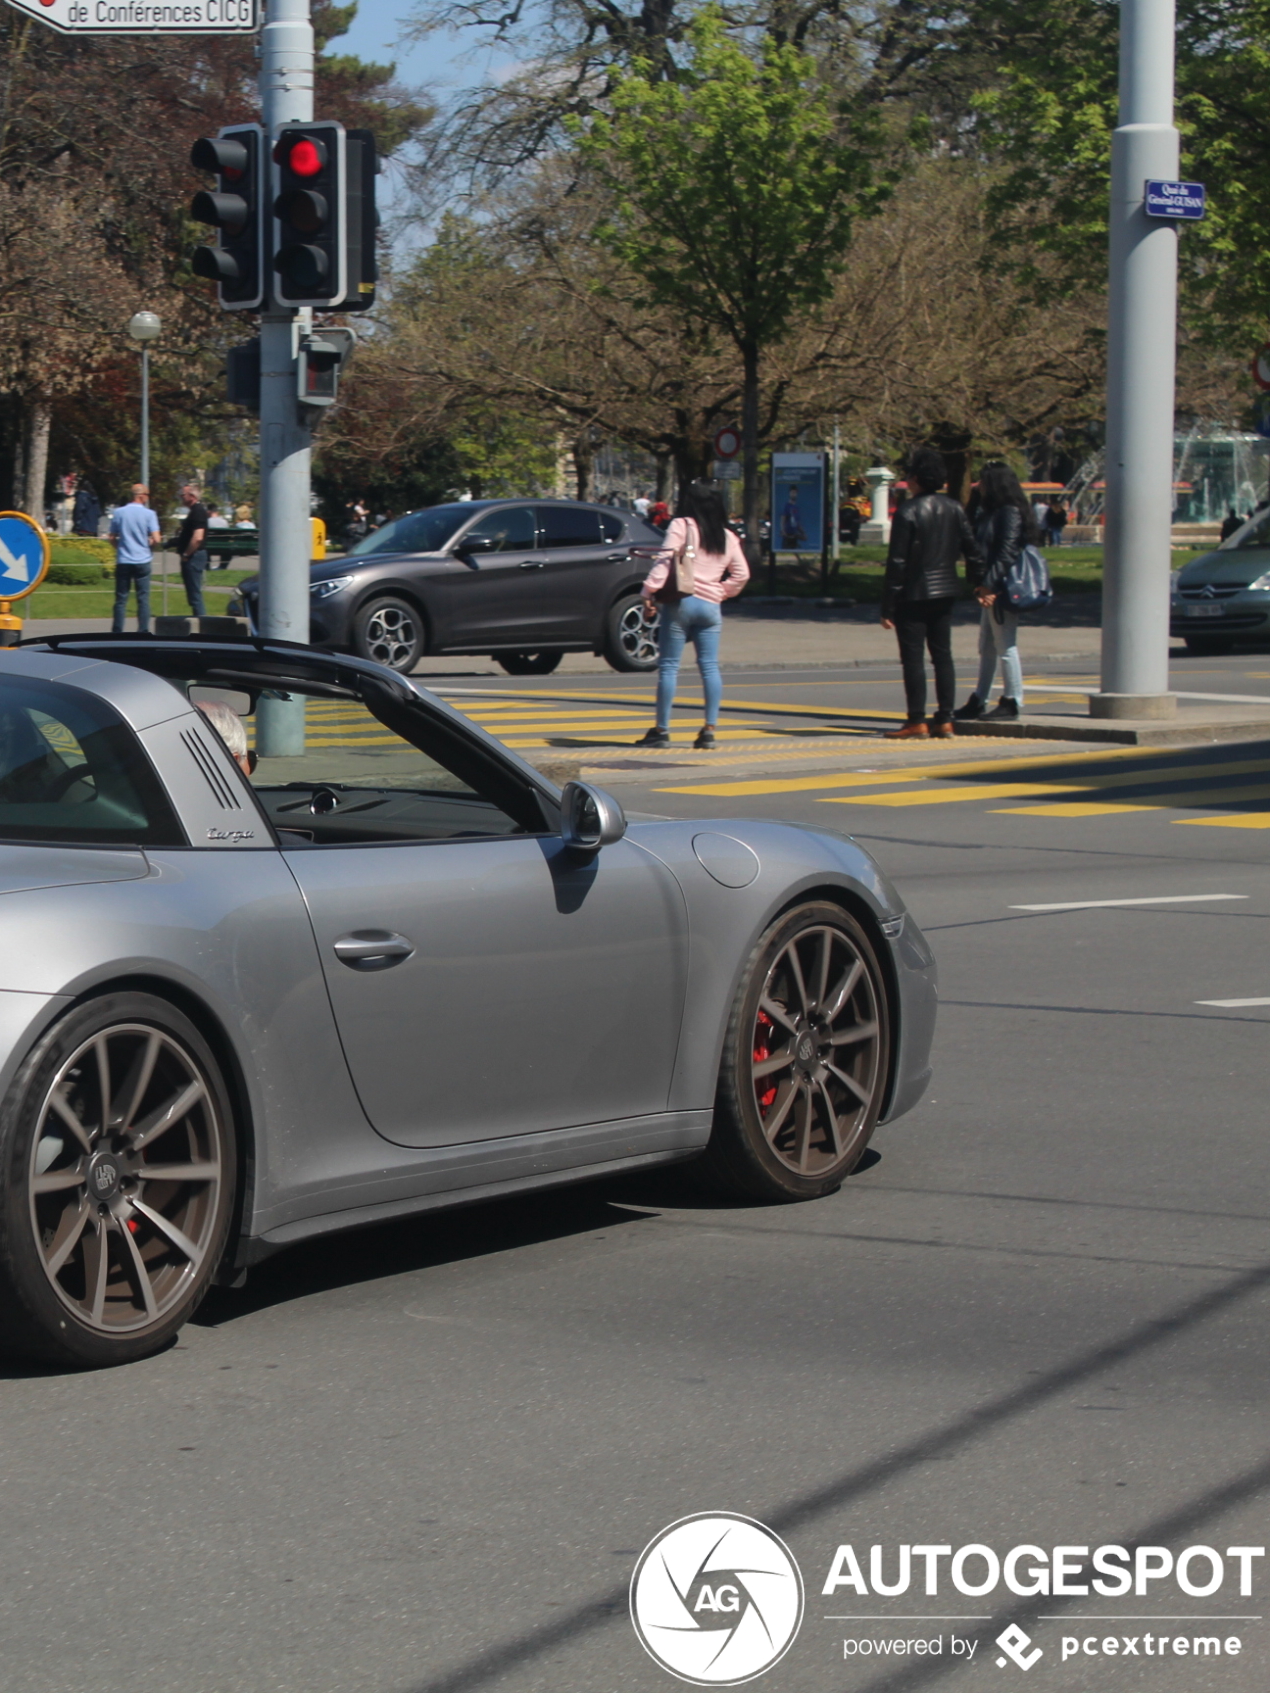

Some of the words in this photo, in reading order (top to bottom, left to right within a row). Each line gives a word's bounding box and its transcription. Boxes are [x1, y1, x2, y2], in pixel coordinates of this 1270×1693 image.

[68, 5, 88, 22] de
[95, 1, 202, 22] Conférences
[206, 0, 250, 21] CICG
[206, 827, 254, 843] Targa
